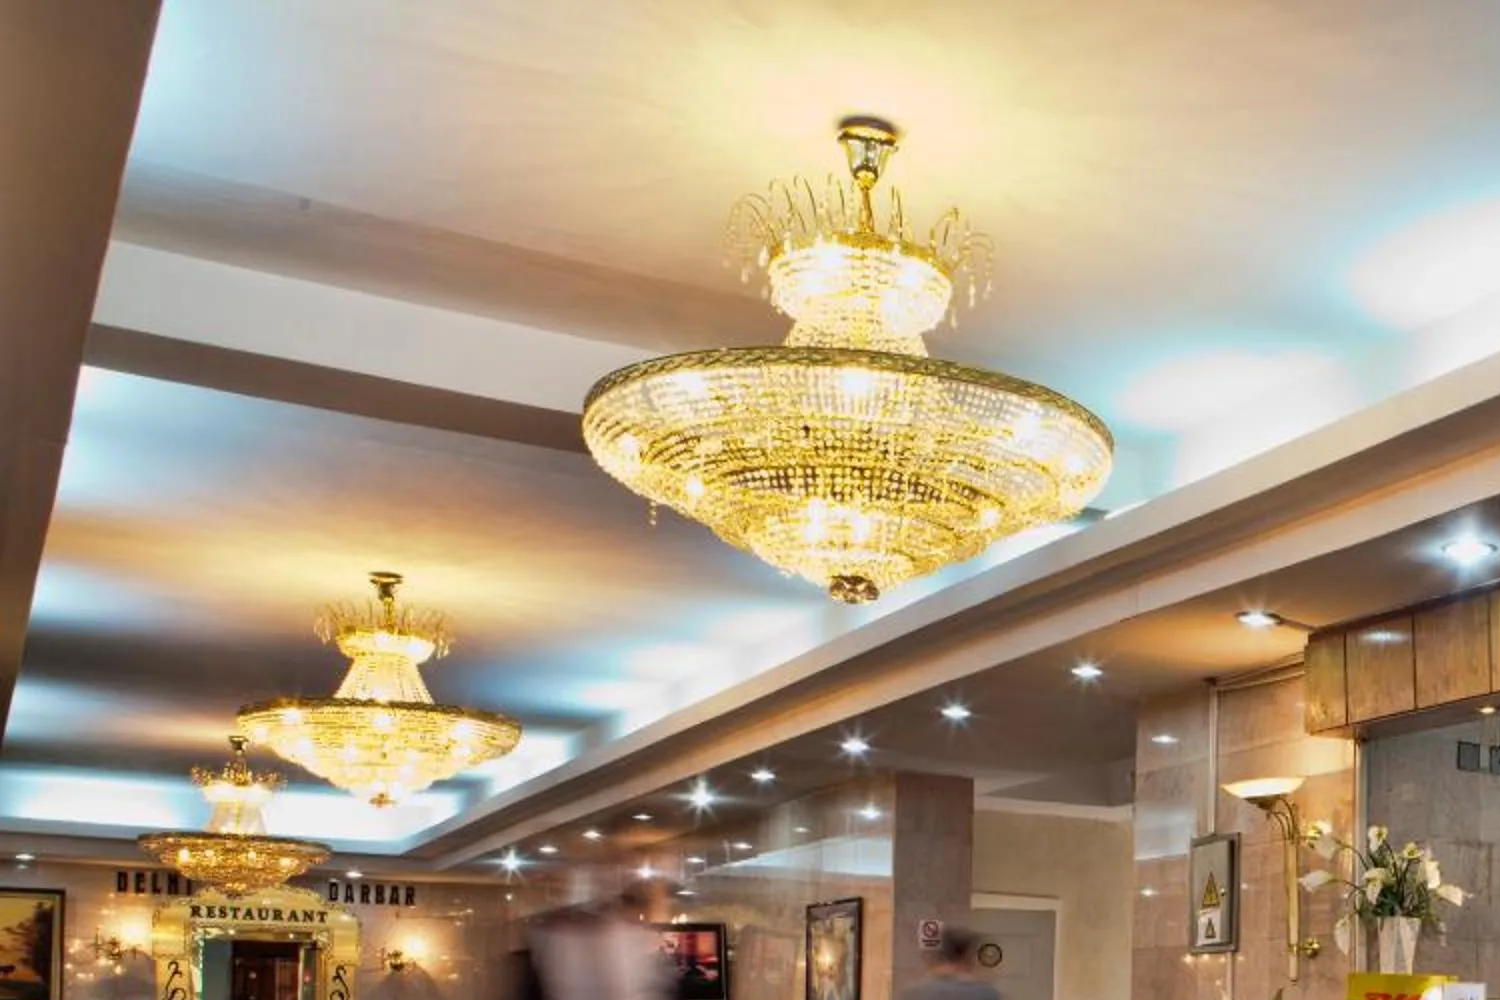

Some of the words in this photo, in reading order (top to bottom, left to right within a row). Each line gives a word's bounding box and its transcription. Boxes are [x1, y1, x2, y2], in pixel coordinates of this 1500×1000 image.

[116, 871, 193, 897] DELHI
[328, 881, 416, 906] DARBAR
[190, 904, 328, 924] RESTAURANT
